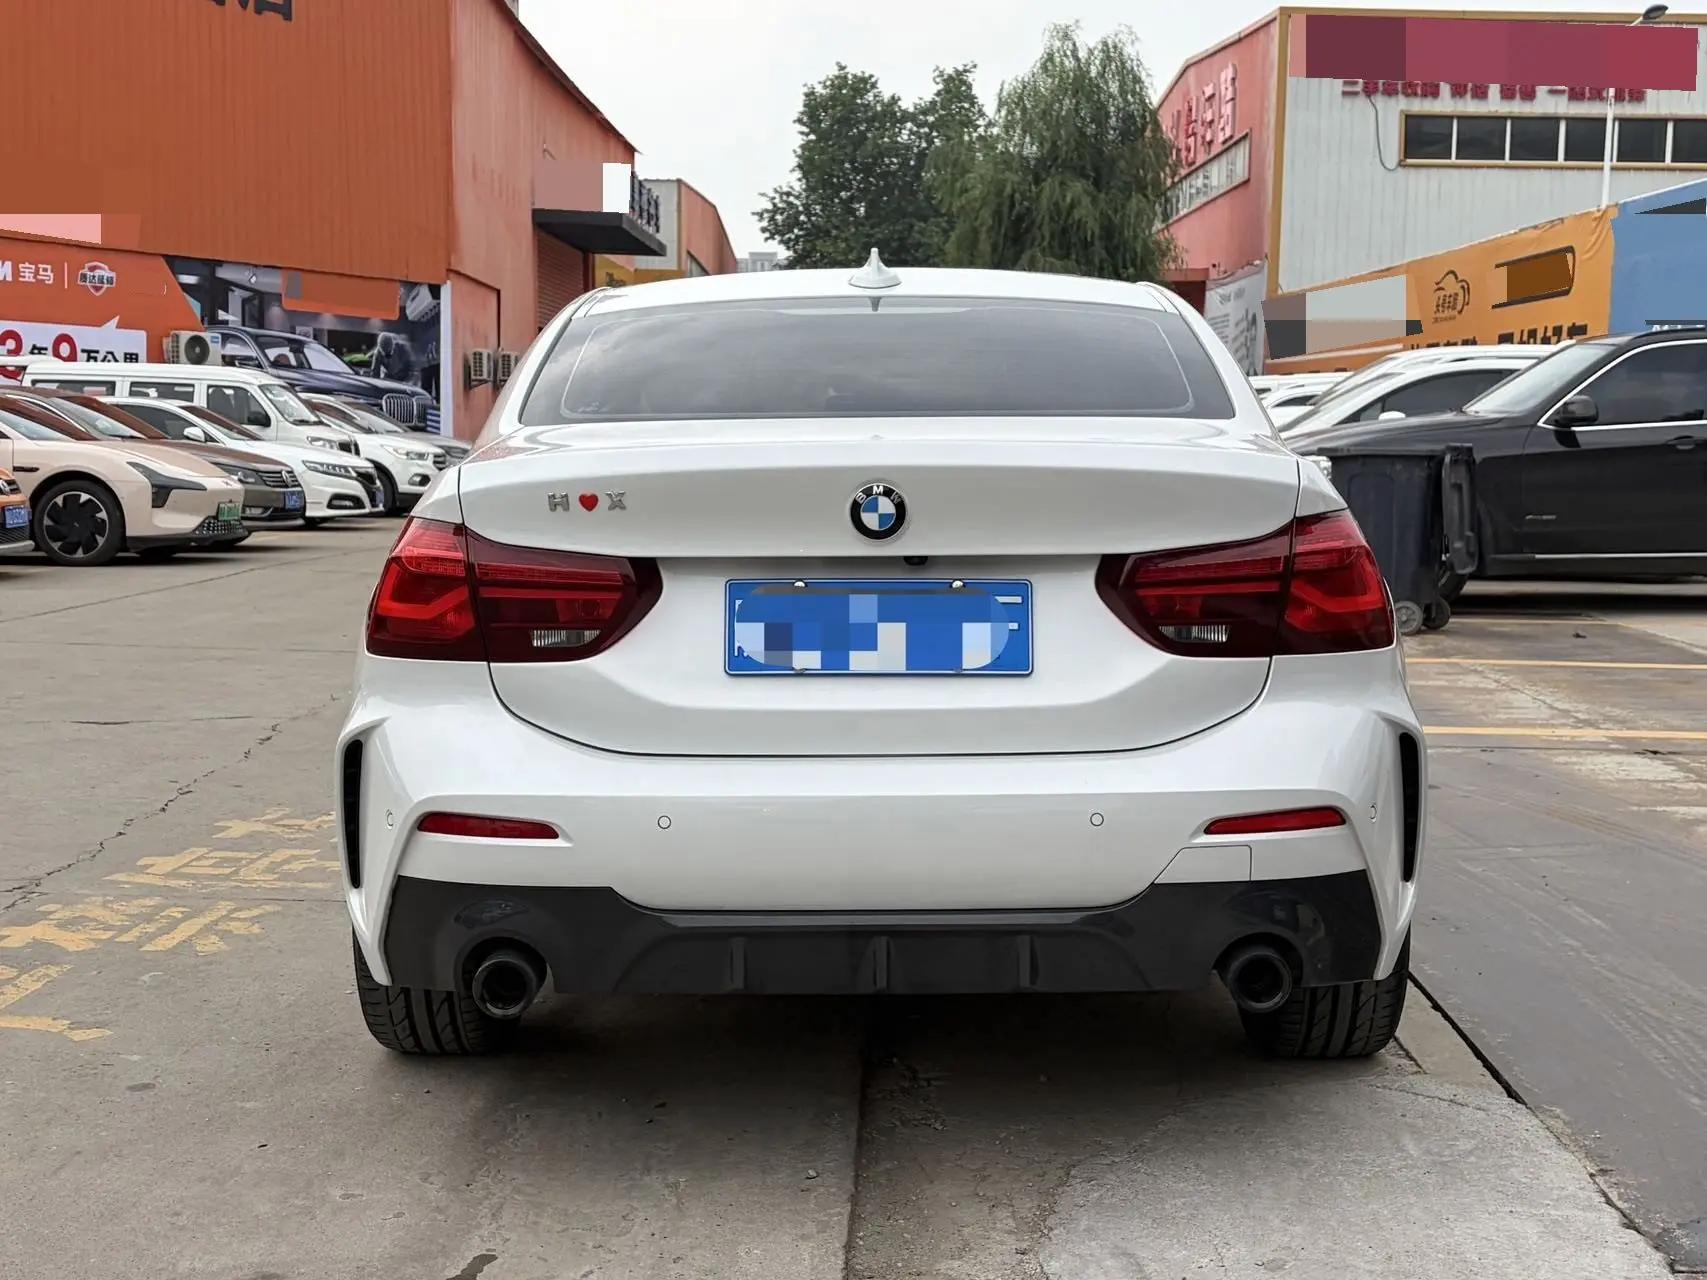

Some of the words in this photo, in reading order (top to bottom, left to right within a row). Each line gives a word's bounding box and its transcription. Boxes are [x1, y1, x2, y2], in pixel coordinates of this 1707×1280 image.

[18, 262, 54, 284] 宝马
[548, 492, 569, 512] H
[604, 490, 627, 511] X
[855, 485, 902, 504] BMW
